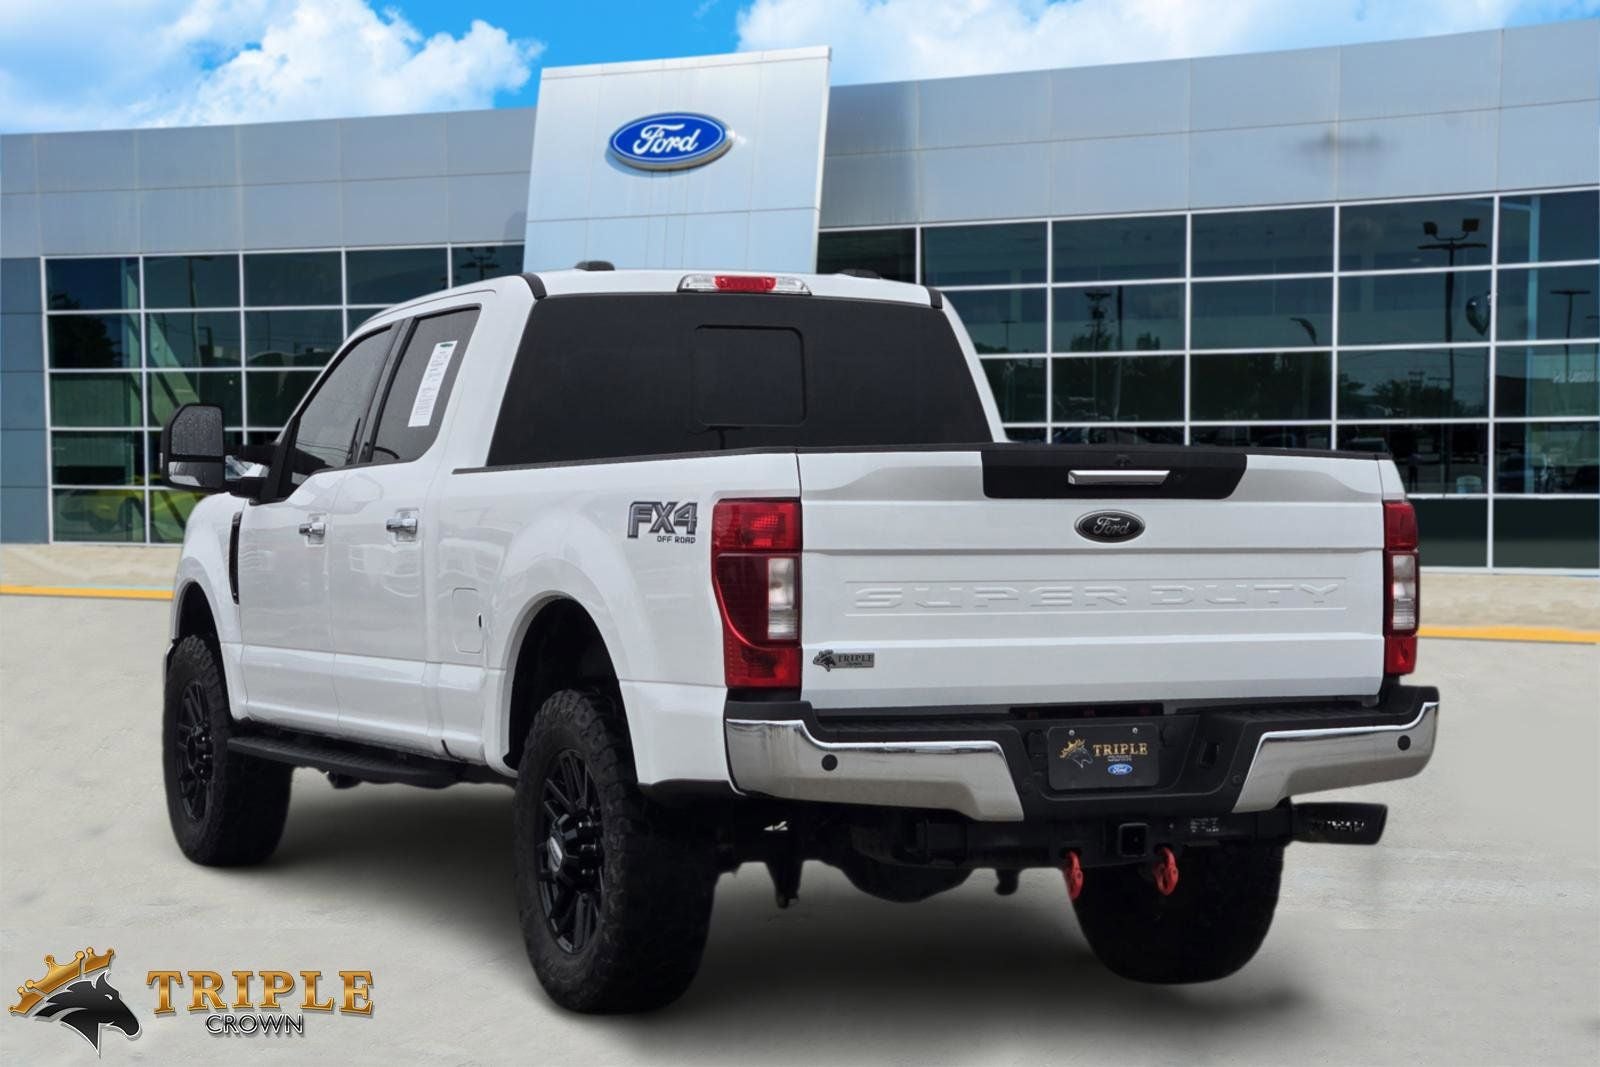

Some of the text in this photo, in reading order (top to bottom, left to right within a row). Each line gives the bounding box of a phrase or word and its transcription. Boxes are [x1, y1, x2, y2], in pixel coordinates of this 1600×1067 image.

[632, 123, 701, 155] Ford
[627, 501, 698, 538] FX4
[1093, 516, 1130, 534] Ford
[656, 535, 696, 544] OFF ROAD
[855, 582, 1340, 608] SUPER DUTY
[837, 654, 873, 663] TRIPLE
[1093, 743, 1148, 757] TRIPLE
